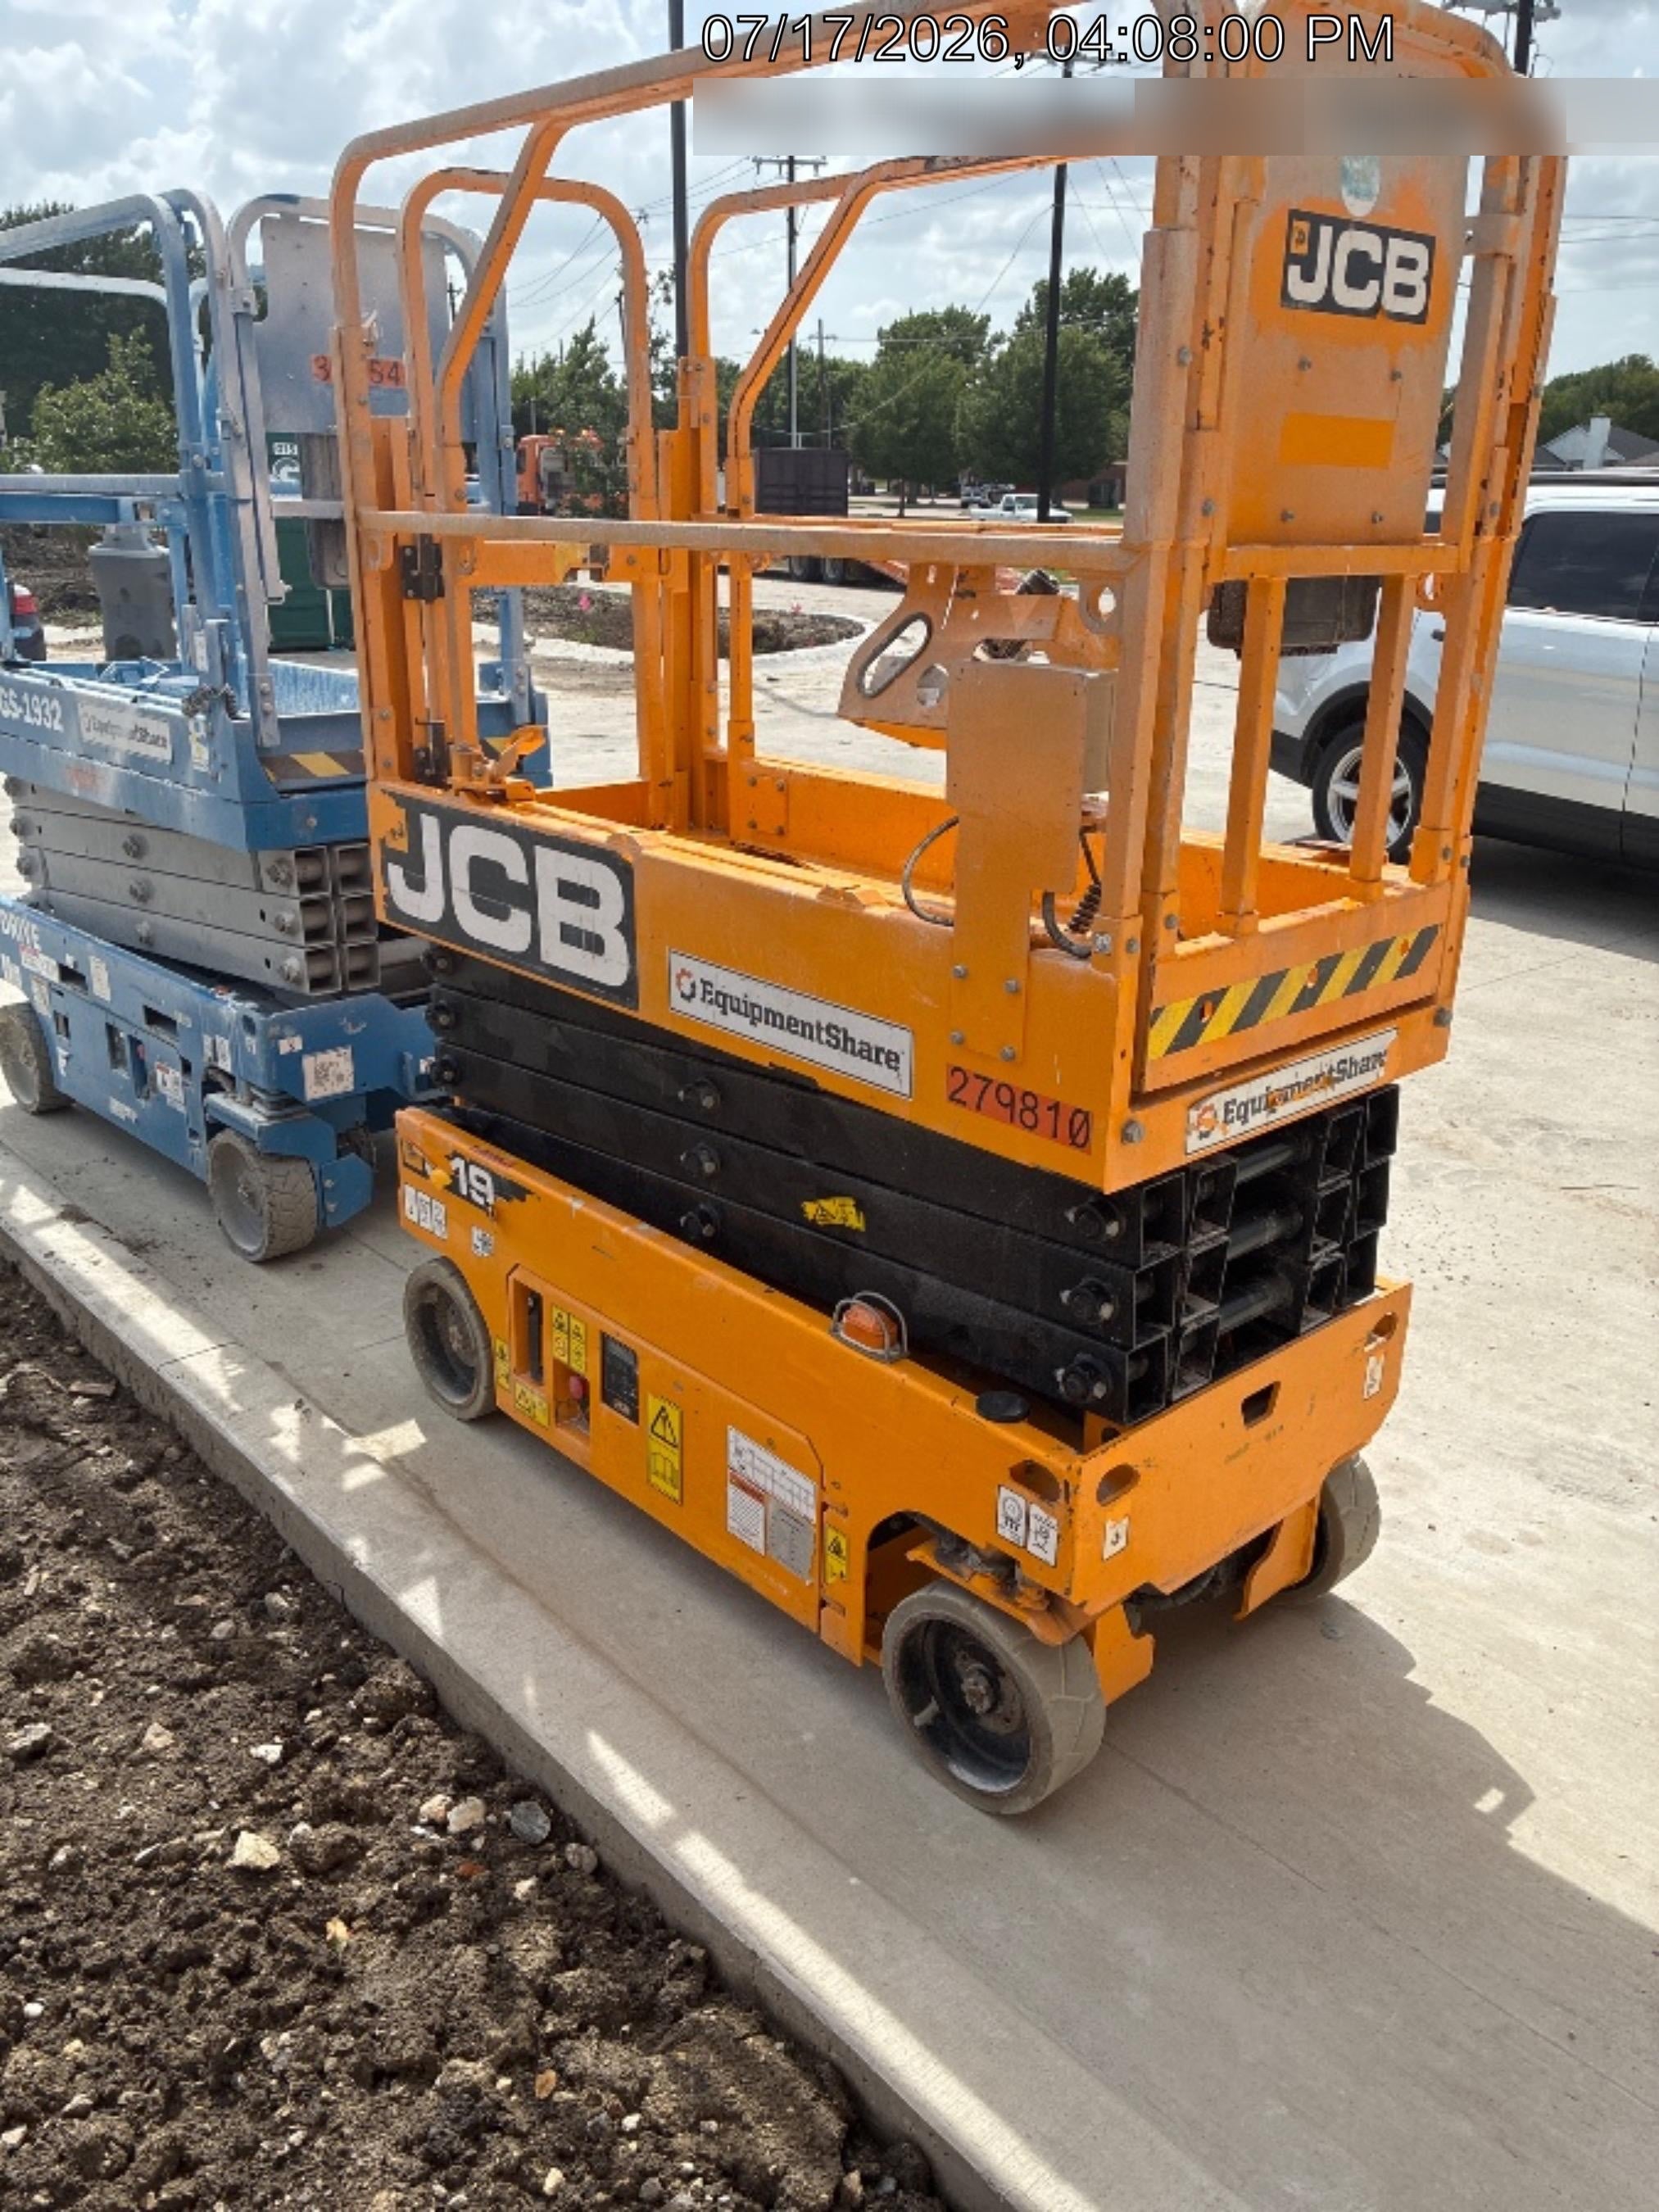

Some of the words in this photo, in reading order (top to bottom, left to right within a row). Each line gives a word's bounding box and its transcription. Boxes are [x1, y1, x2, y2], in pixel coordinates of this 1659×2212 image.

[1288, 225, 1430, 315] JCB
[388, 813, 630, 986] JCB
[700, 978, 900, 1072] EquipmentShare
[949, 1066, 1090, 1149] 279810
[450, 1156, 496, 1207] 19
